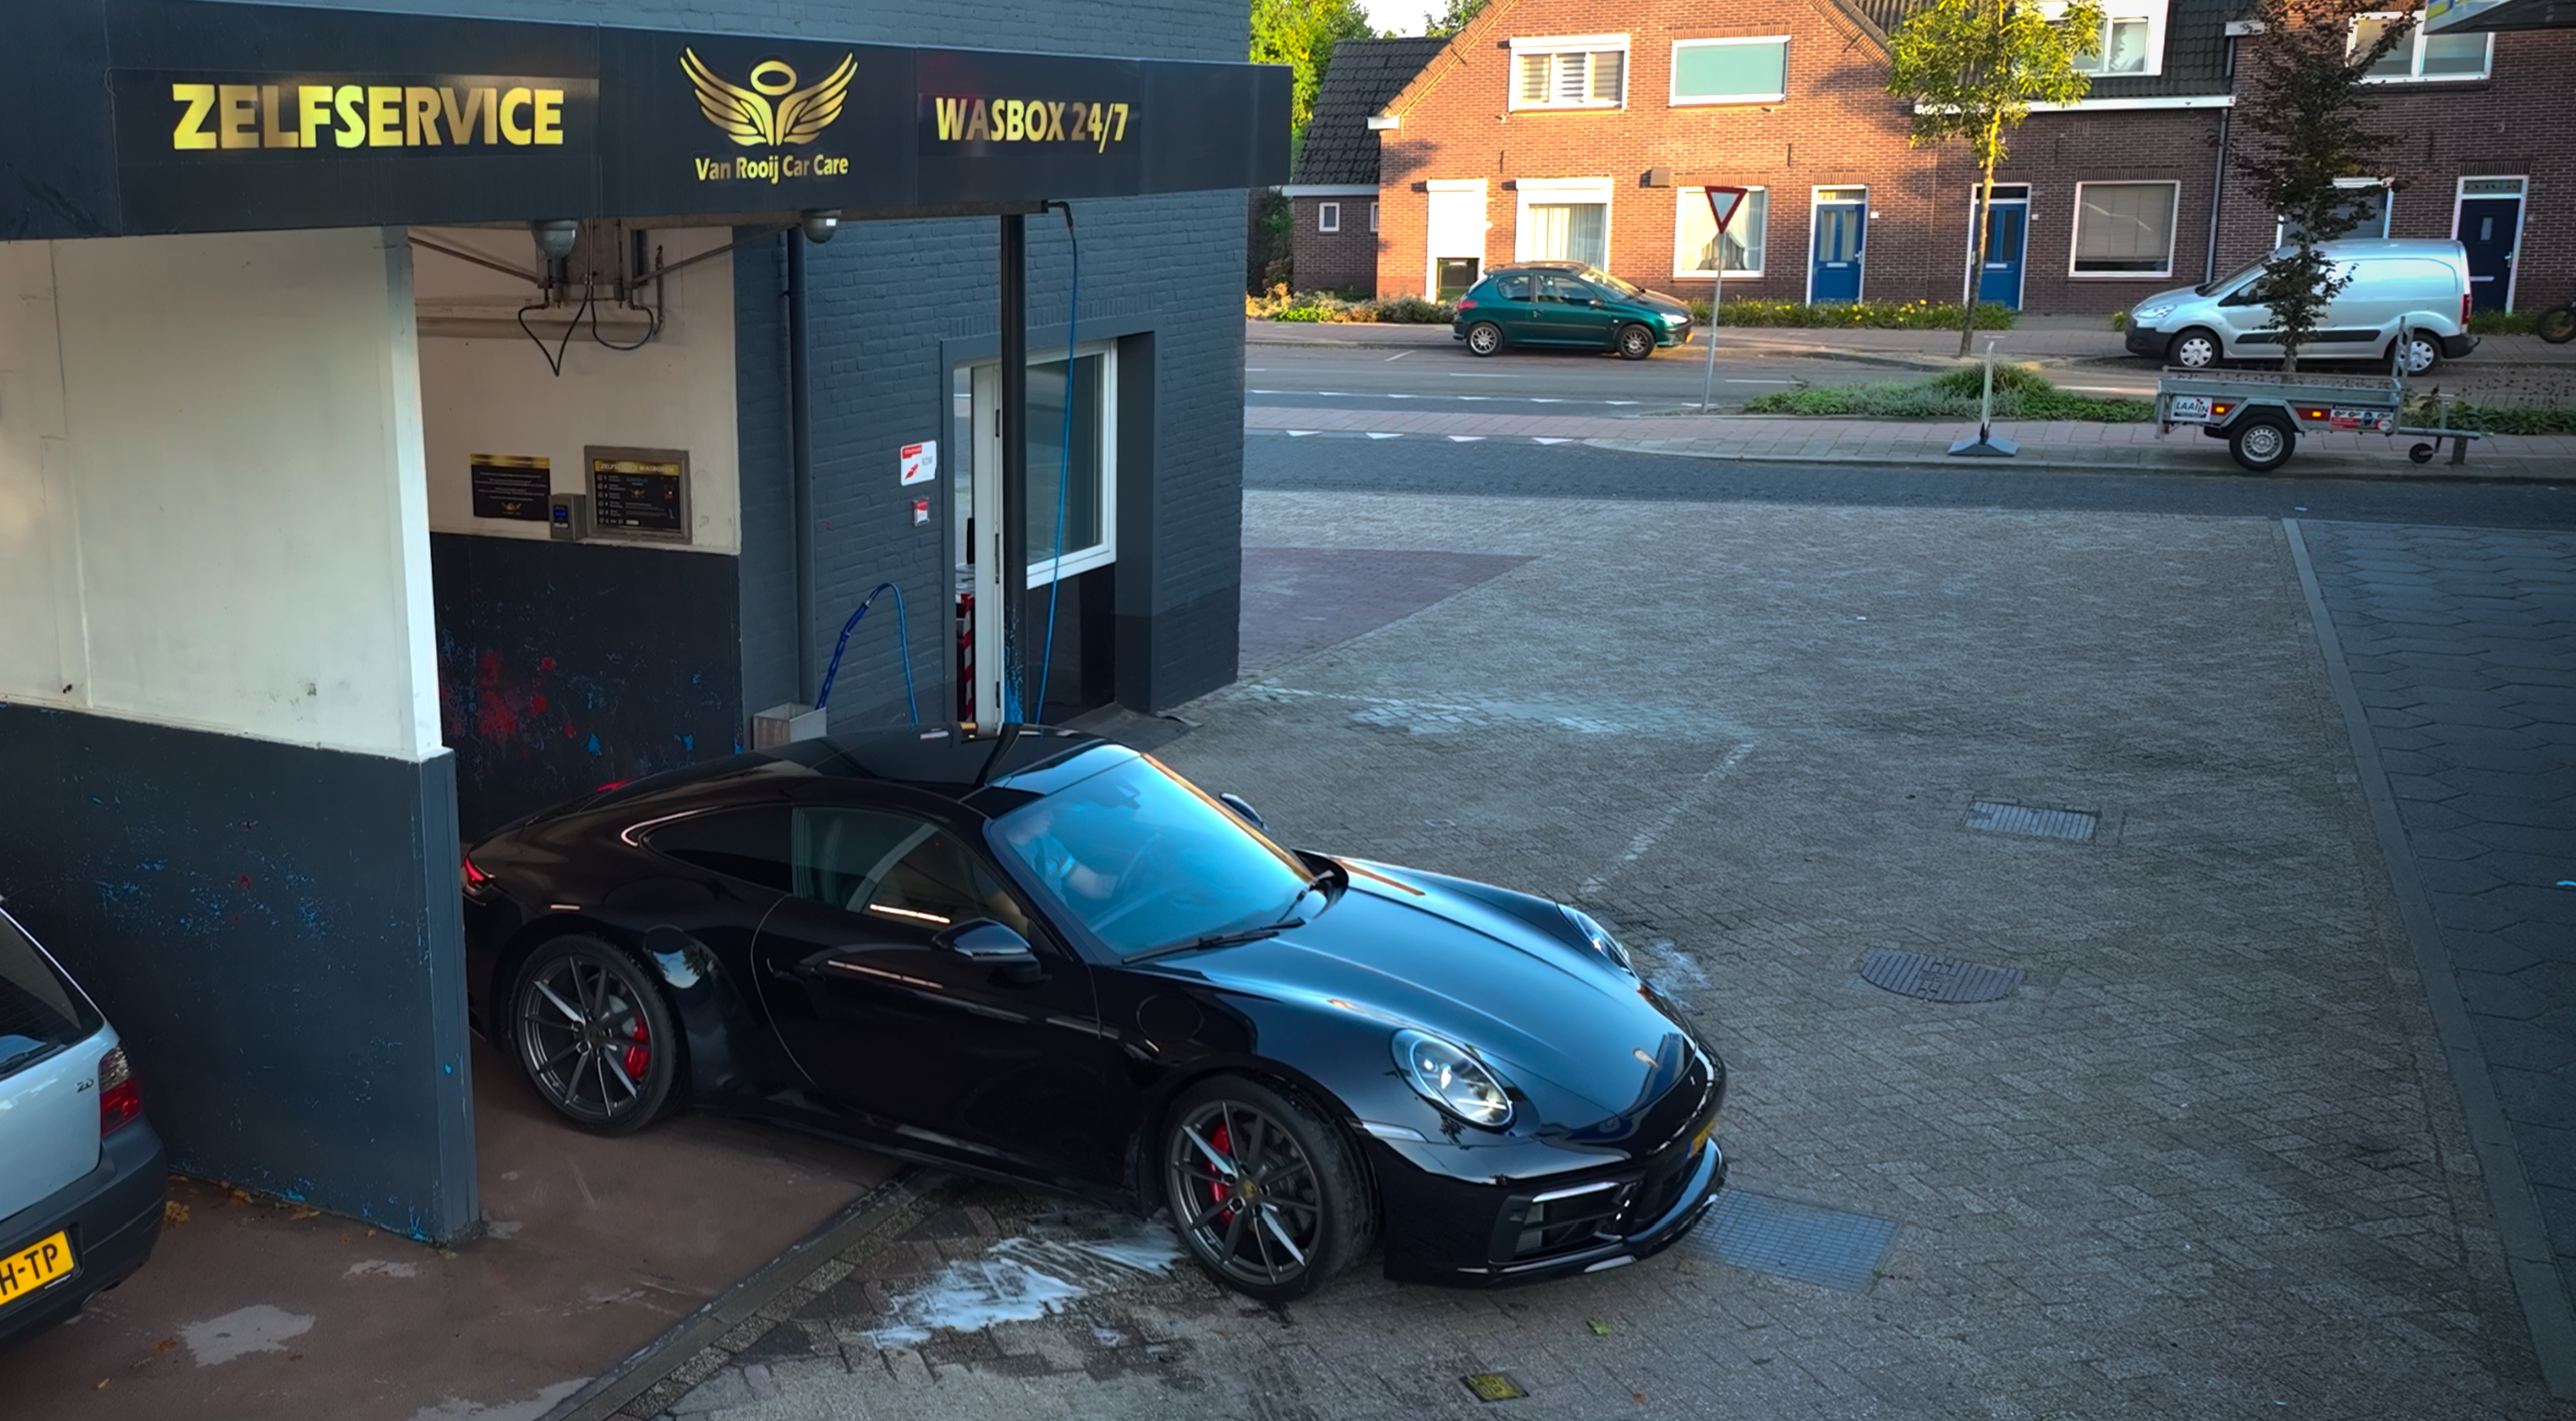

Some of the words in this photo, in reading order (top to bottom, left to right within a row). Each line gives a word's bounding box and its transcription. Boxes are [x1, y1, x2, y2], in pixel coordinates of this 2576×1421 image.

[173, 84, 564, 150] ZELFSERVICE
[935, 97, 1066, 141] WASBOX
[1071, 102, 1129, 154] 24/7
[695, 158, 731, 181] Van
[736, 155, 779, 184] Rooij
[782, 155, 810, 177] Car
[814, 154, 849, 176] Care
